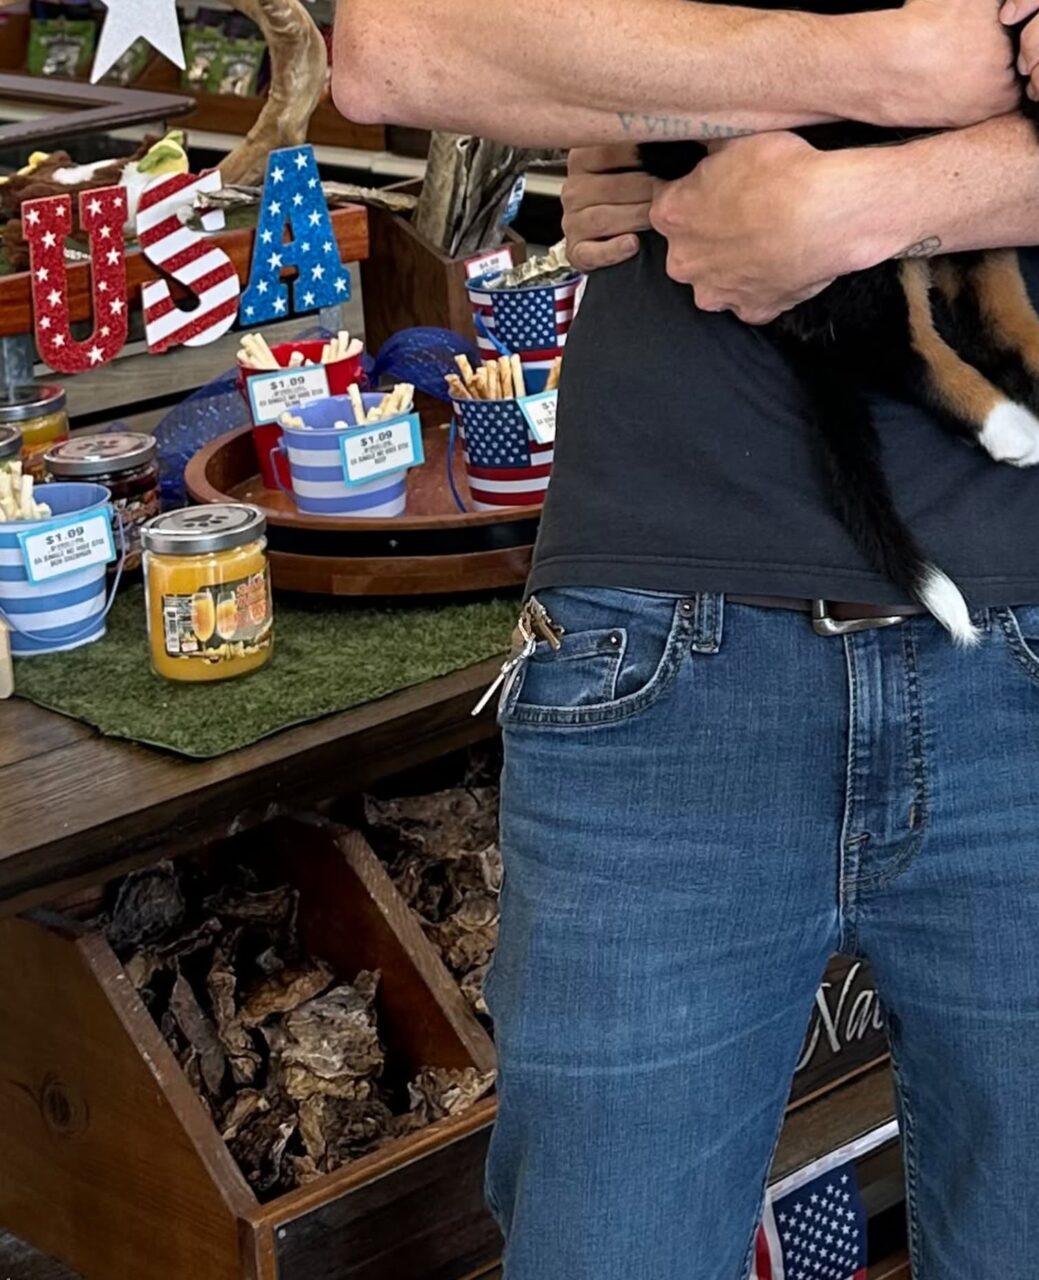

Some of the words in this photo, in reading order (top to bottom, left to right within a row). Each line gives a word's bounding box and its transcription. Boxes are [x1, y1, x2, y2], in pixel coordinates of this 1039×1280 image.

[21, 144, 351, 373] USA
[270, 376, 305, 390] $1.09
[361, 430, 392, 447] $1.09
[46, 527, 84, 545] $1.09
